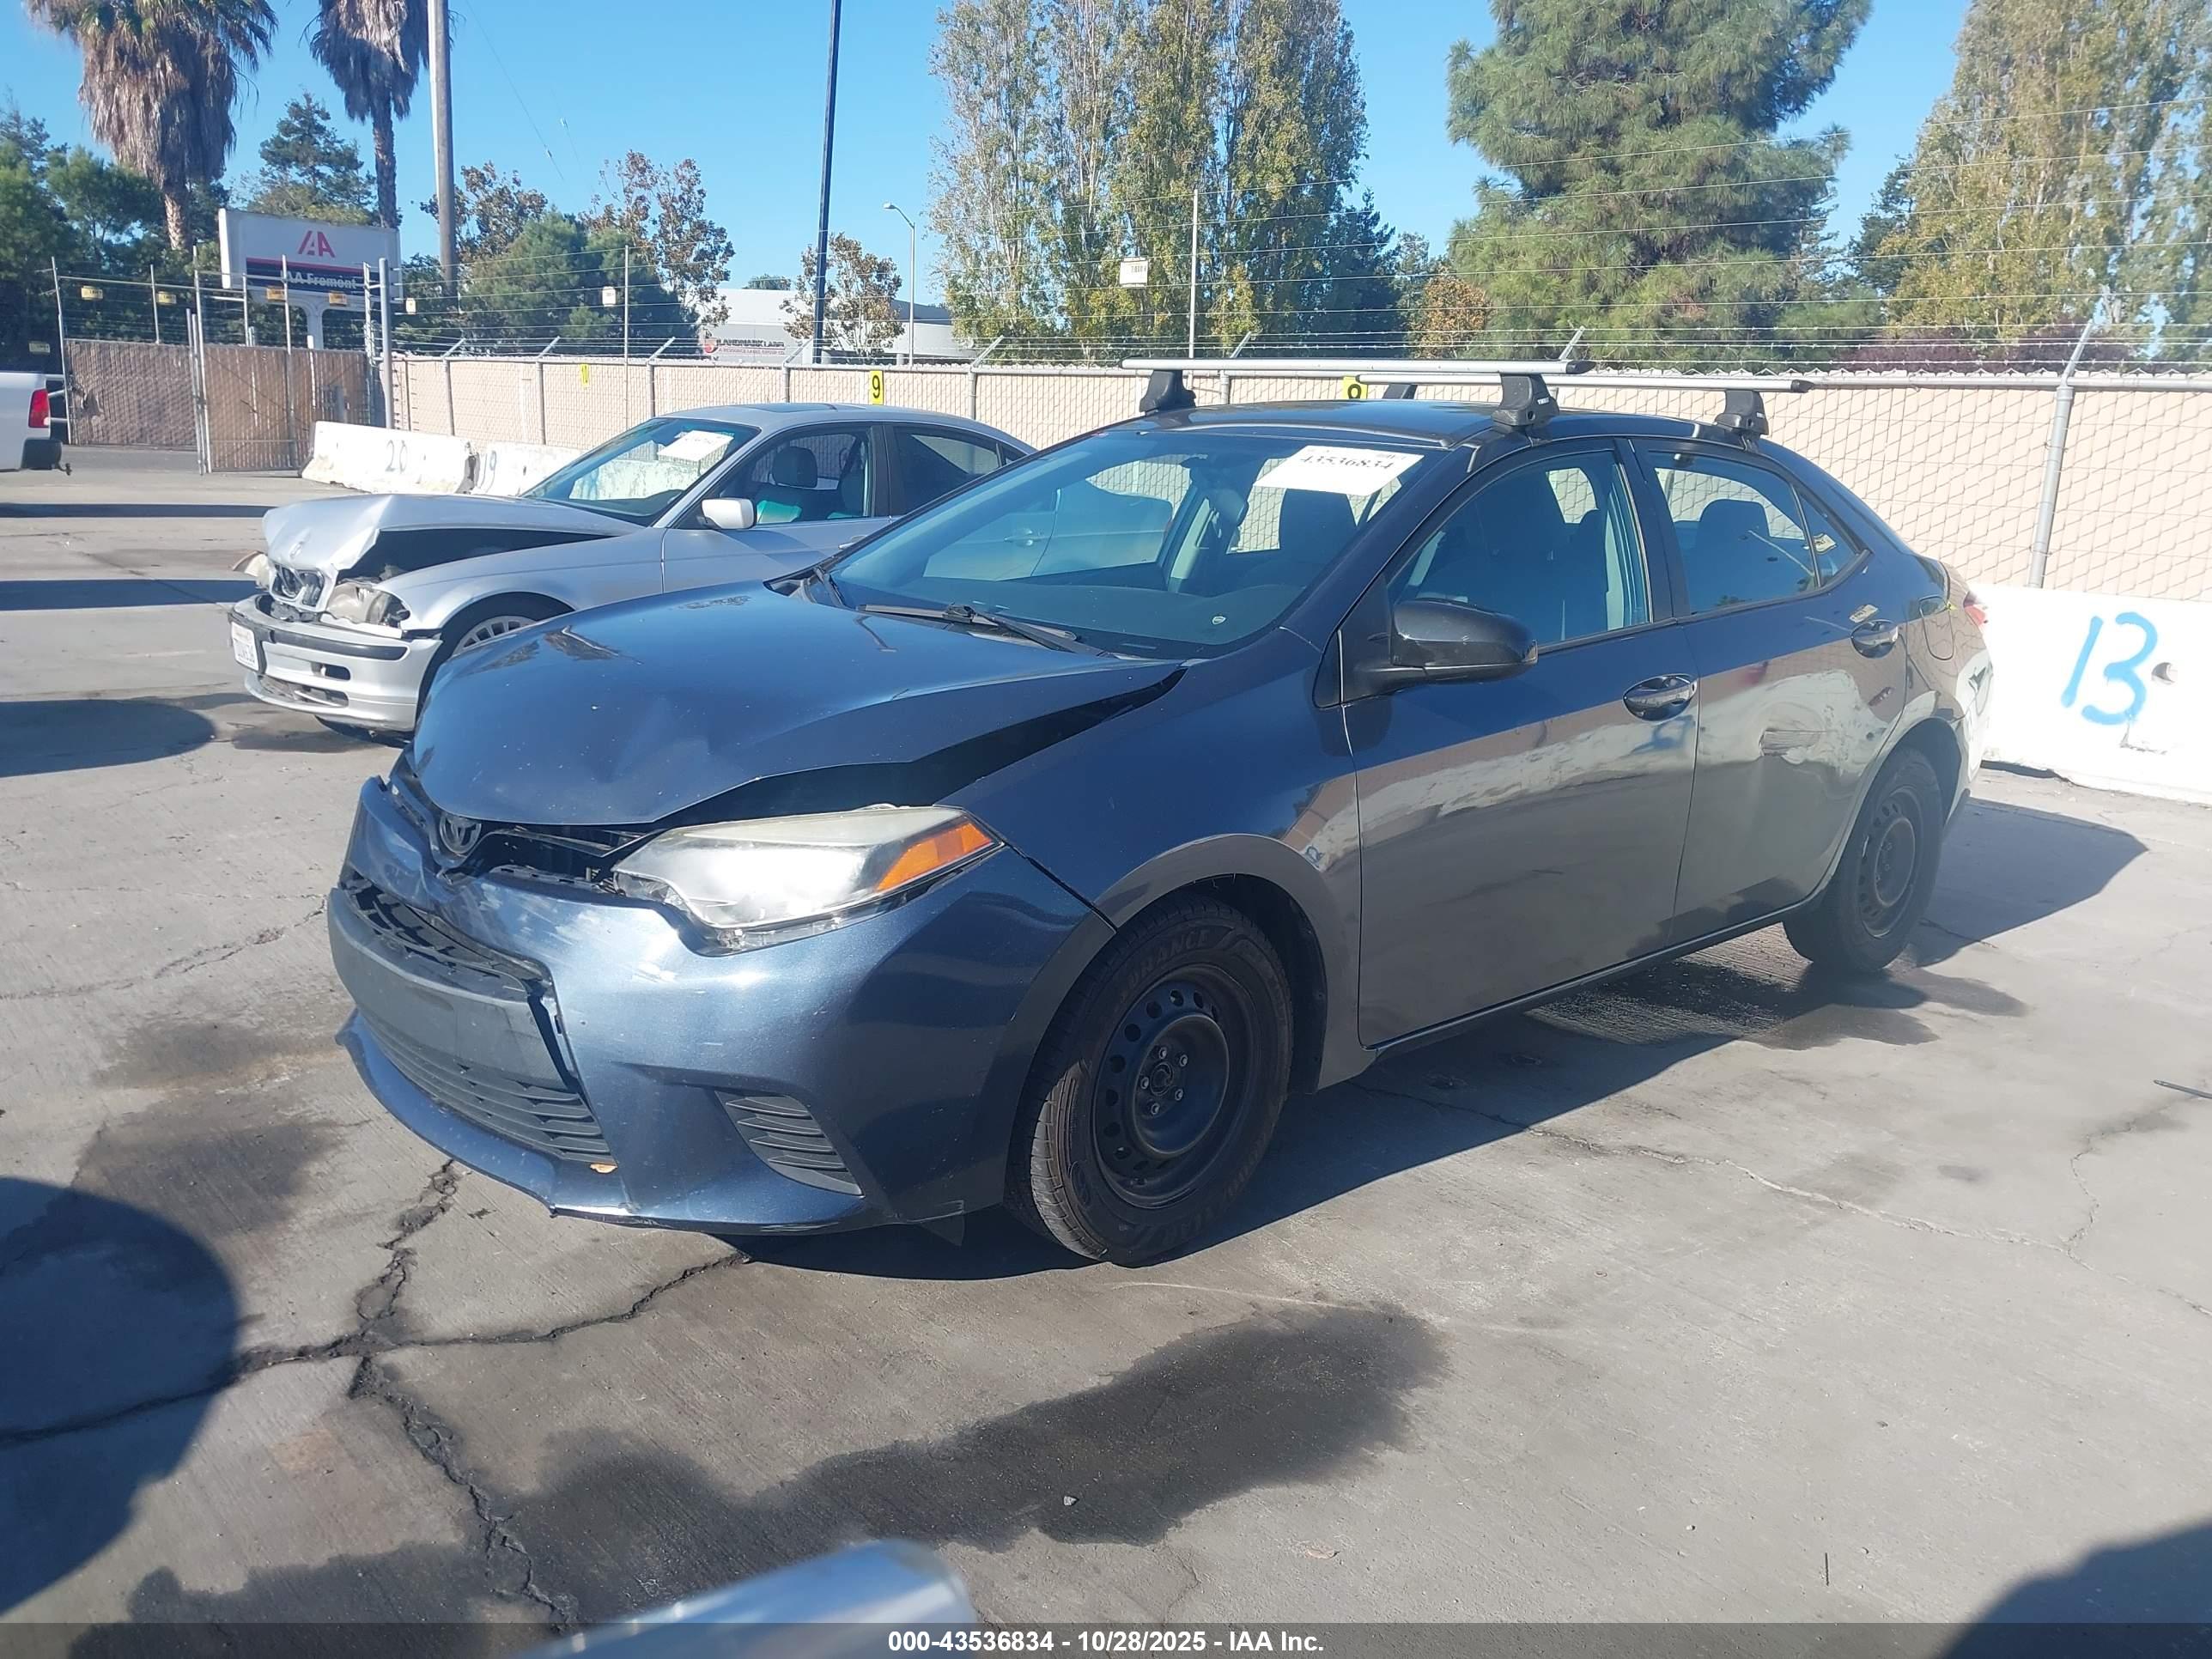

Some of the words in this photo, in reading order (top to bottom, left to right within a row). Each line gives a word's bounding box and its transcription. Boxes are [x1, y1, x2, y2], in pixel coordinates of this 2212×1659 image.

[307, 273, 356, 289] Fremont
[872, 374, 881, 399] 9
[386, 439, 409, 472] 20
[2061, 611, 2158, 726] 13
